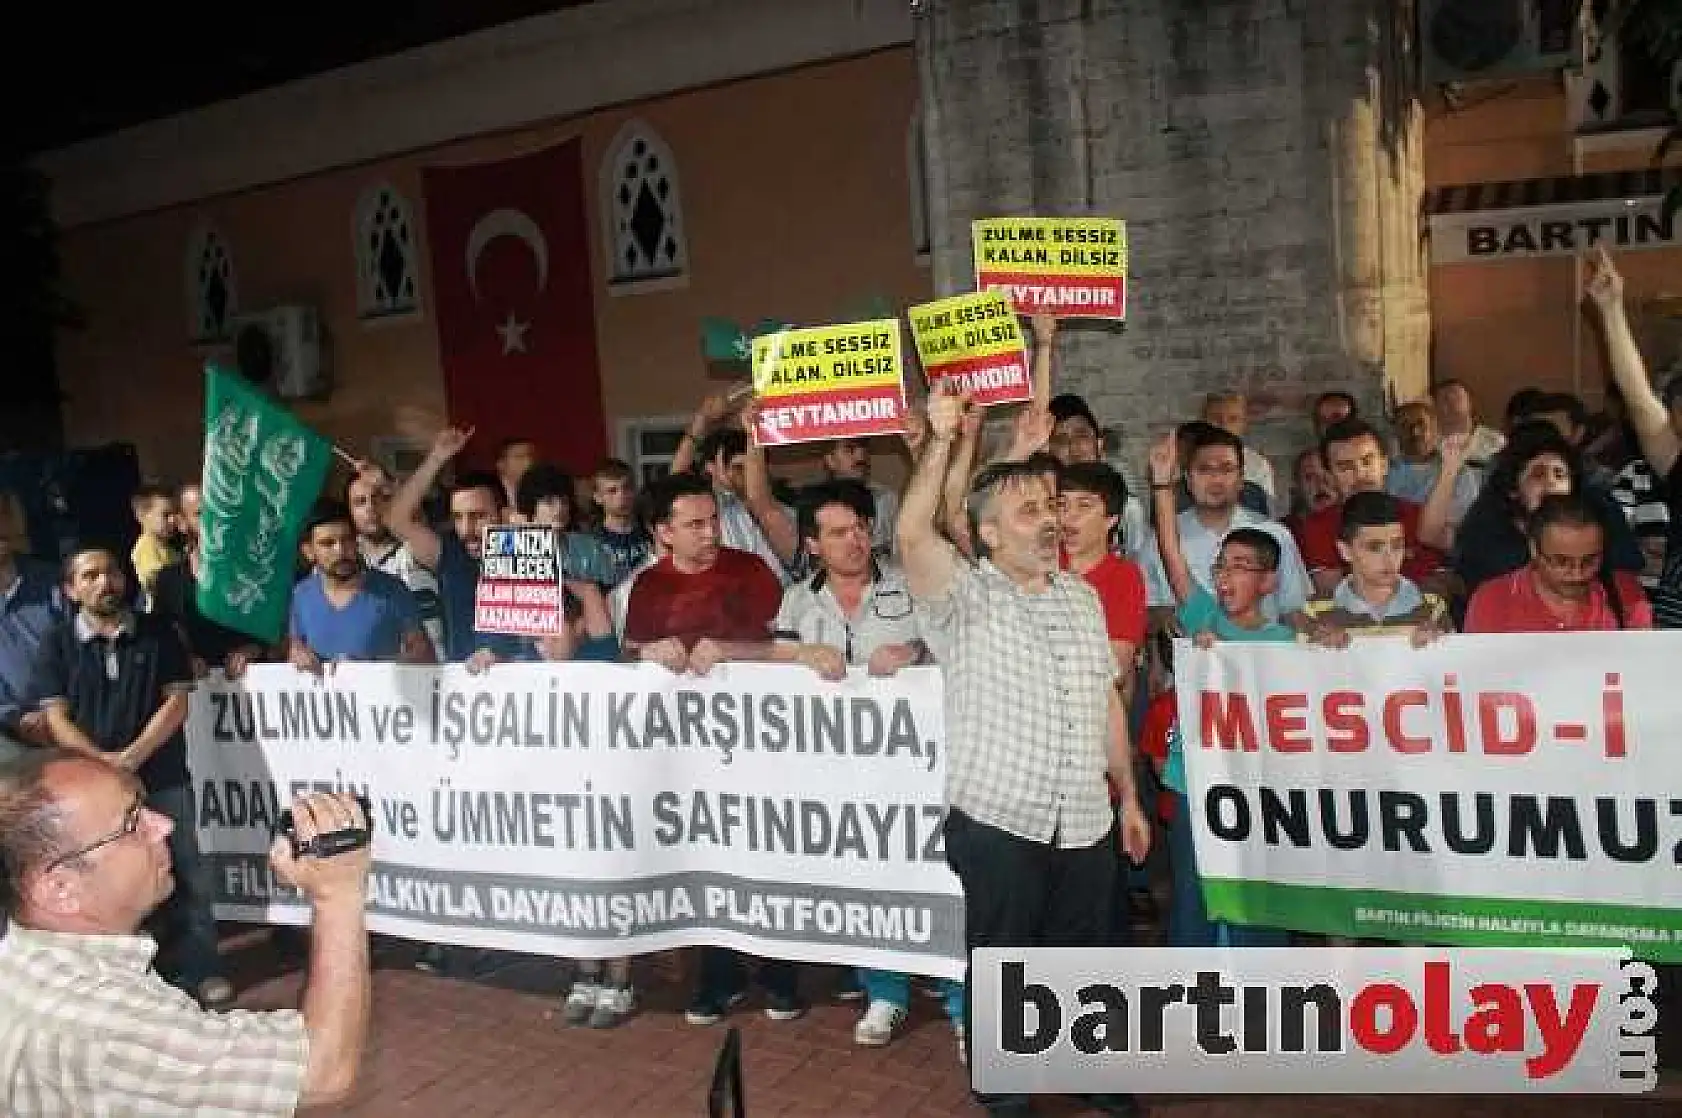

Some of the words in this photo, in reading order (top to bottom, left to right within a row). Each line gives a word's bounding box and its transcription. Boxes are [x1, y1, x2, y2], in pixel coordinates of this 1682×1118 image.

[1467, 215, 1673, 256] BARTIN
[369, 704, 415, 743] ve
[430, 678, 591, 761] İŞGALİN
[608, 690, 937, 771] KARŞISINDA,
[380, 799, 420, 841] ve
[431, 777, 636, 851] ÜMMETİN
[653, 790, 947, 863] SAFINDAYIZ
[1205, 783, 1682, 864] ONURUMU
[490, 886, 695, 937] DAYANIŞMA
[704, 885, 932, 943] PLATFORMU
